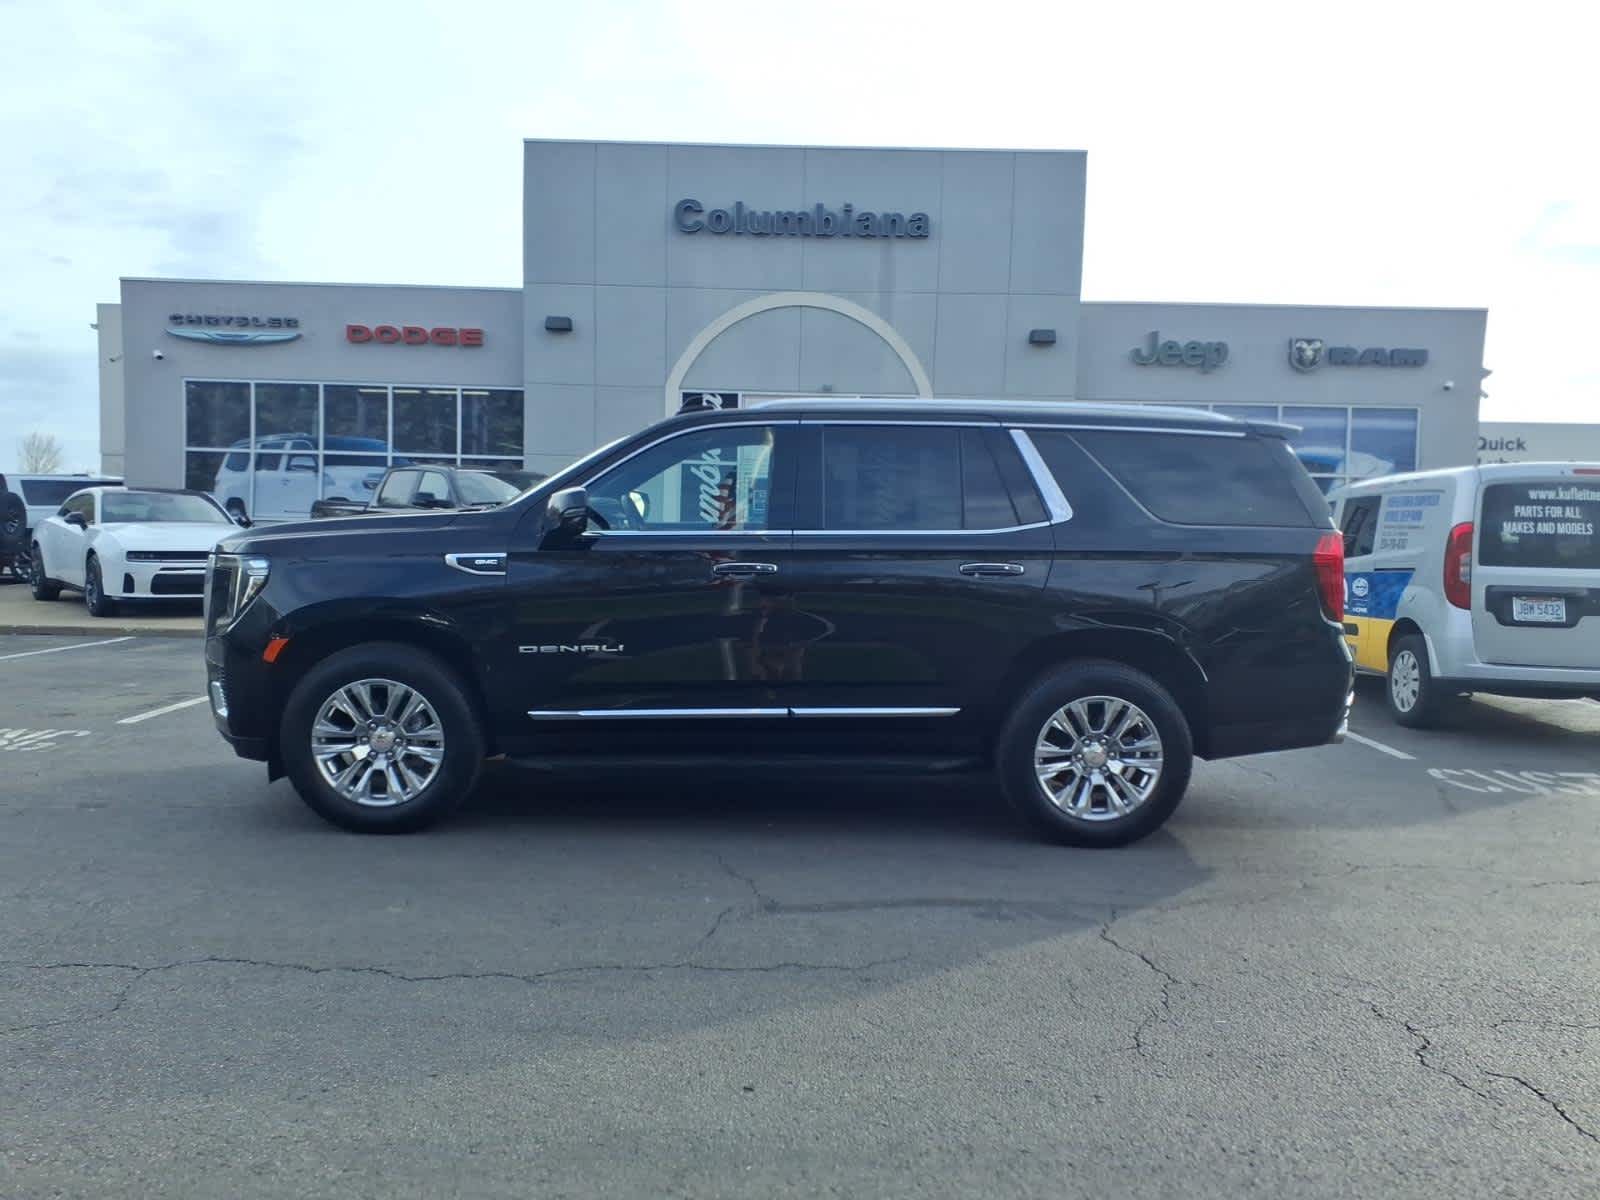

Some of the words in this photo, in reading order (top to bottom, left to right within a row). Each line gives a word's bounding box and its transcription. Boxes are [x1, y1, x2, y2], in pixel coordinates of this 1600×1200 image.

[674, 198, 930, 238] Columbiana
[169, 313, 299, 329] CHRYSLER
[346, 324, 483, 347] DODGE
[1131, 330, 1229, 373] Jeep
[1328, 347, 1428, 367] RAM
[1477, 436, 1527, 451] Quick
[1513, 505, 1543, 518] PARTS
[1544, 506, 1563, 518] FOR
[1564, 506, 1582, 519] ALL
[1503, 521, 1535, 534] MAKES
[1536, 522, 1556, 534] AND
[1556, 522, 1593, 535] MODELS
[518, 644, 624, 653] DENALI
